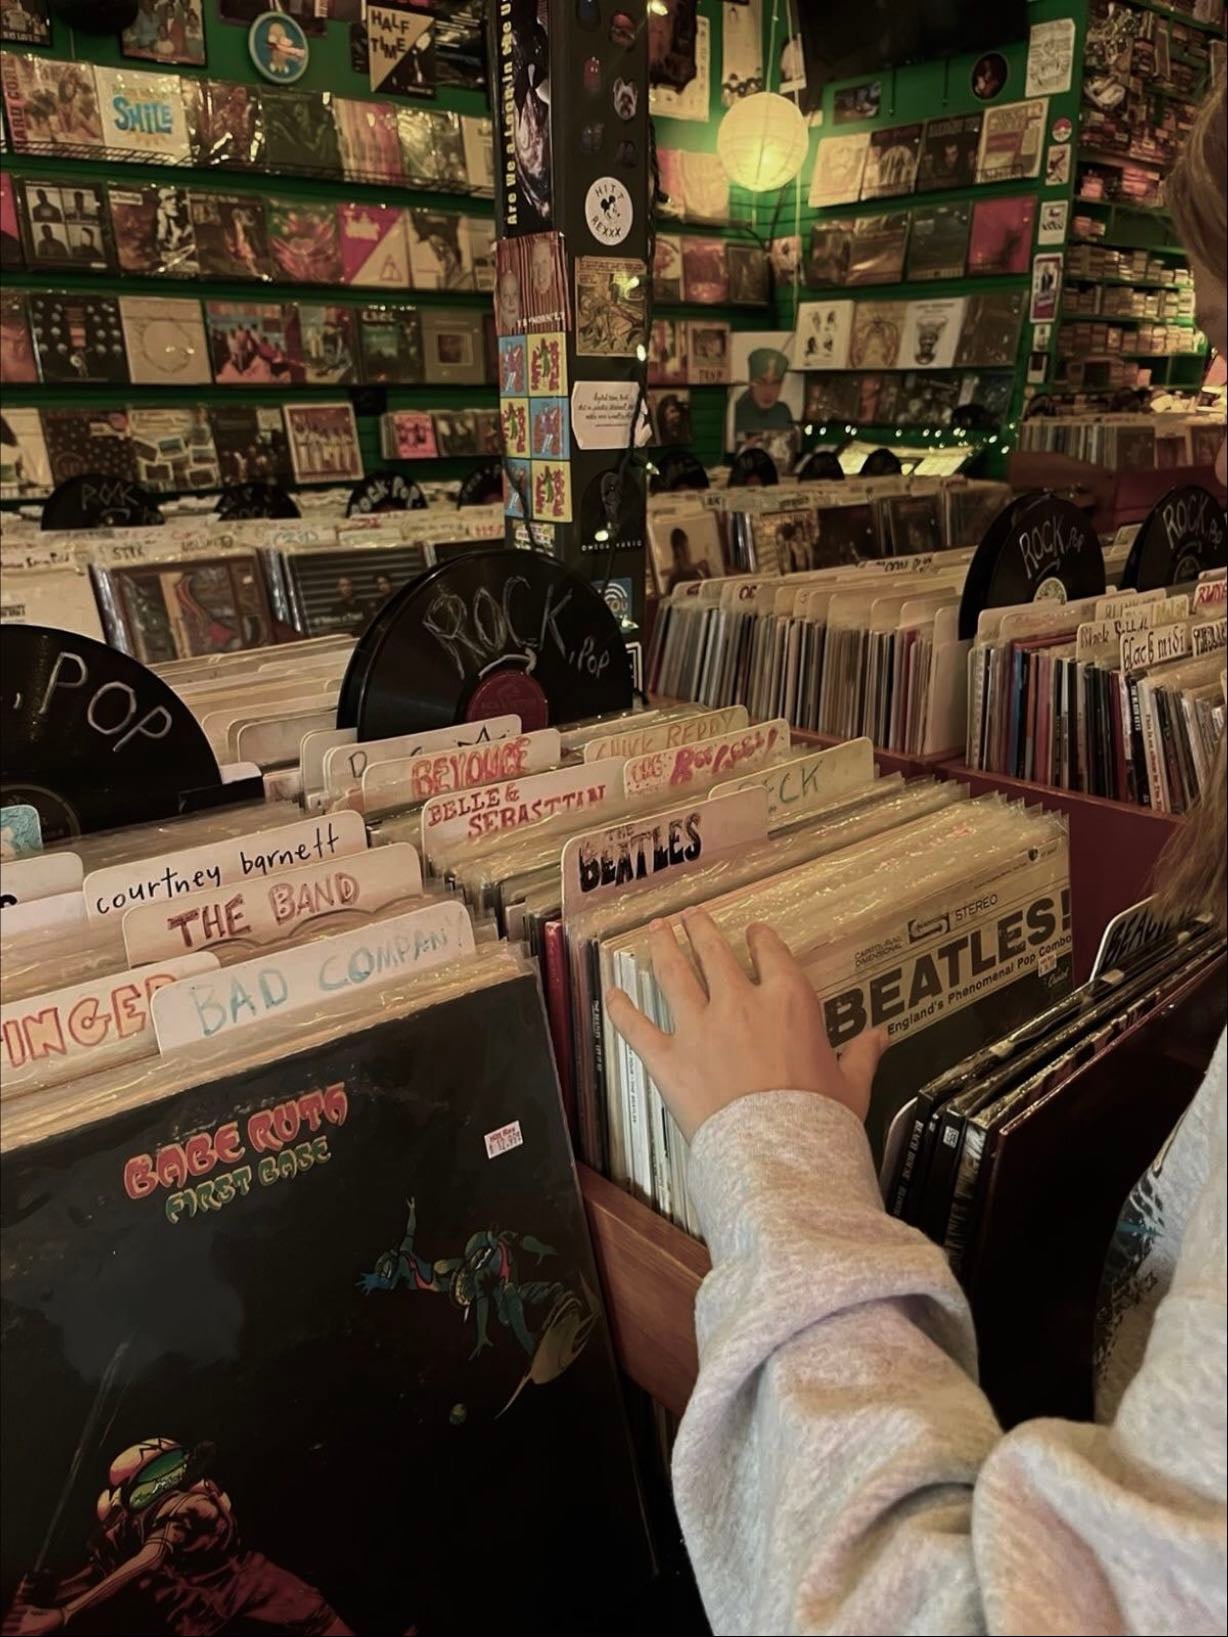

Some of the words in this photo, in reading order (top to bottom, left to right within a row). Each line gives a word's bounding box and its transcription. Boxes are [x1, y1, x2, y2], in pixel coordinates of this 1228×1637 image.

[371, 9, 409, 34] HALF
[371, 35, 406, 60] TIME
[112, 95, 173, 134] SMILE
[505, 160, 517, 187] We
[506, 192, 518, 225] Are
[38, 651, 173, 752] POP
[428, 785, 500, 827] BELLE
[96, 864, 221, 914] courtney
[240, 823, 340, 876] barnett
[579, 812, 702, 893] BEATLES
[167, 893, 252, 948] THE
[268, 871, 361, 927] BAND
[955, 893, 999, 922] STEREO
[189, 968, 290, 1037] BAD
[823, 887, 1073, 1048] BEATLES!
[887, 1000, 944, 1036] England's
[948, 966, 1014, 1004] Phenomenal
[1017, 954, 1036, 971] Pop
[1038, 935, 1073, 959] Combo
[124, 1121, 246, 1199] BABE
[247, 1081, 348, 1153] RUTH
[165, 1165, 252, 1225] FIRST
[258, 1135, 332, 1187] BASE
